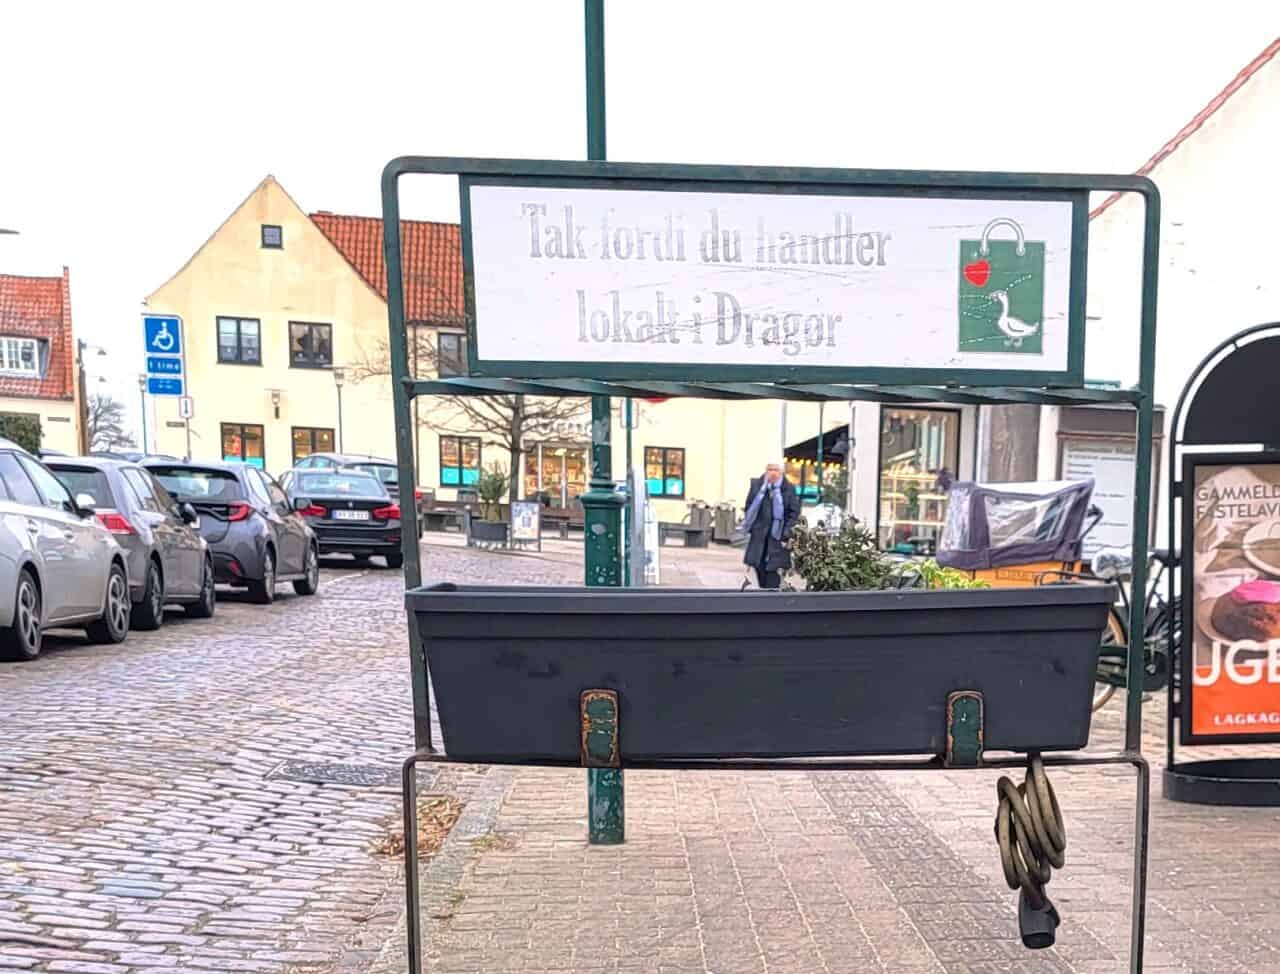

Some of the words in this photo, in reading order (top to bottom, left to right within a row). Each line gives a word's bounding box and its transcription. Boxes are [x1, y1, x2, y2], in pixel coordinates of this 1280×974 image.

[521, 202, 588, 260] Tak
[699, 207, 743, 263] du
[756, 211, 892, 267] handler
[576, 289, 681, 344] lokalt
[692, 295, 703, 344] i
